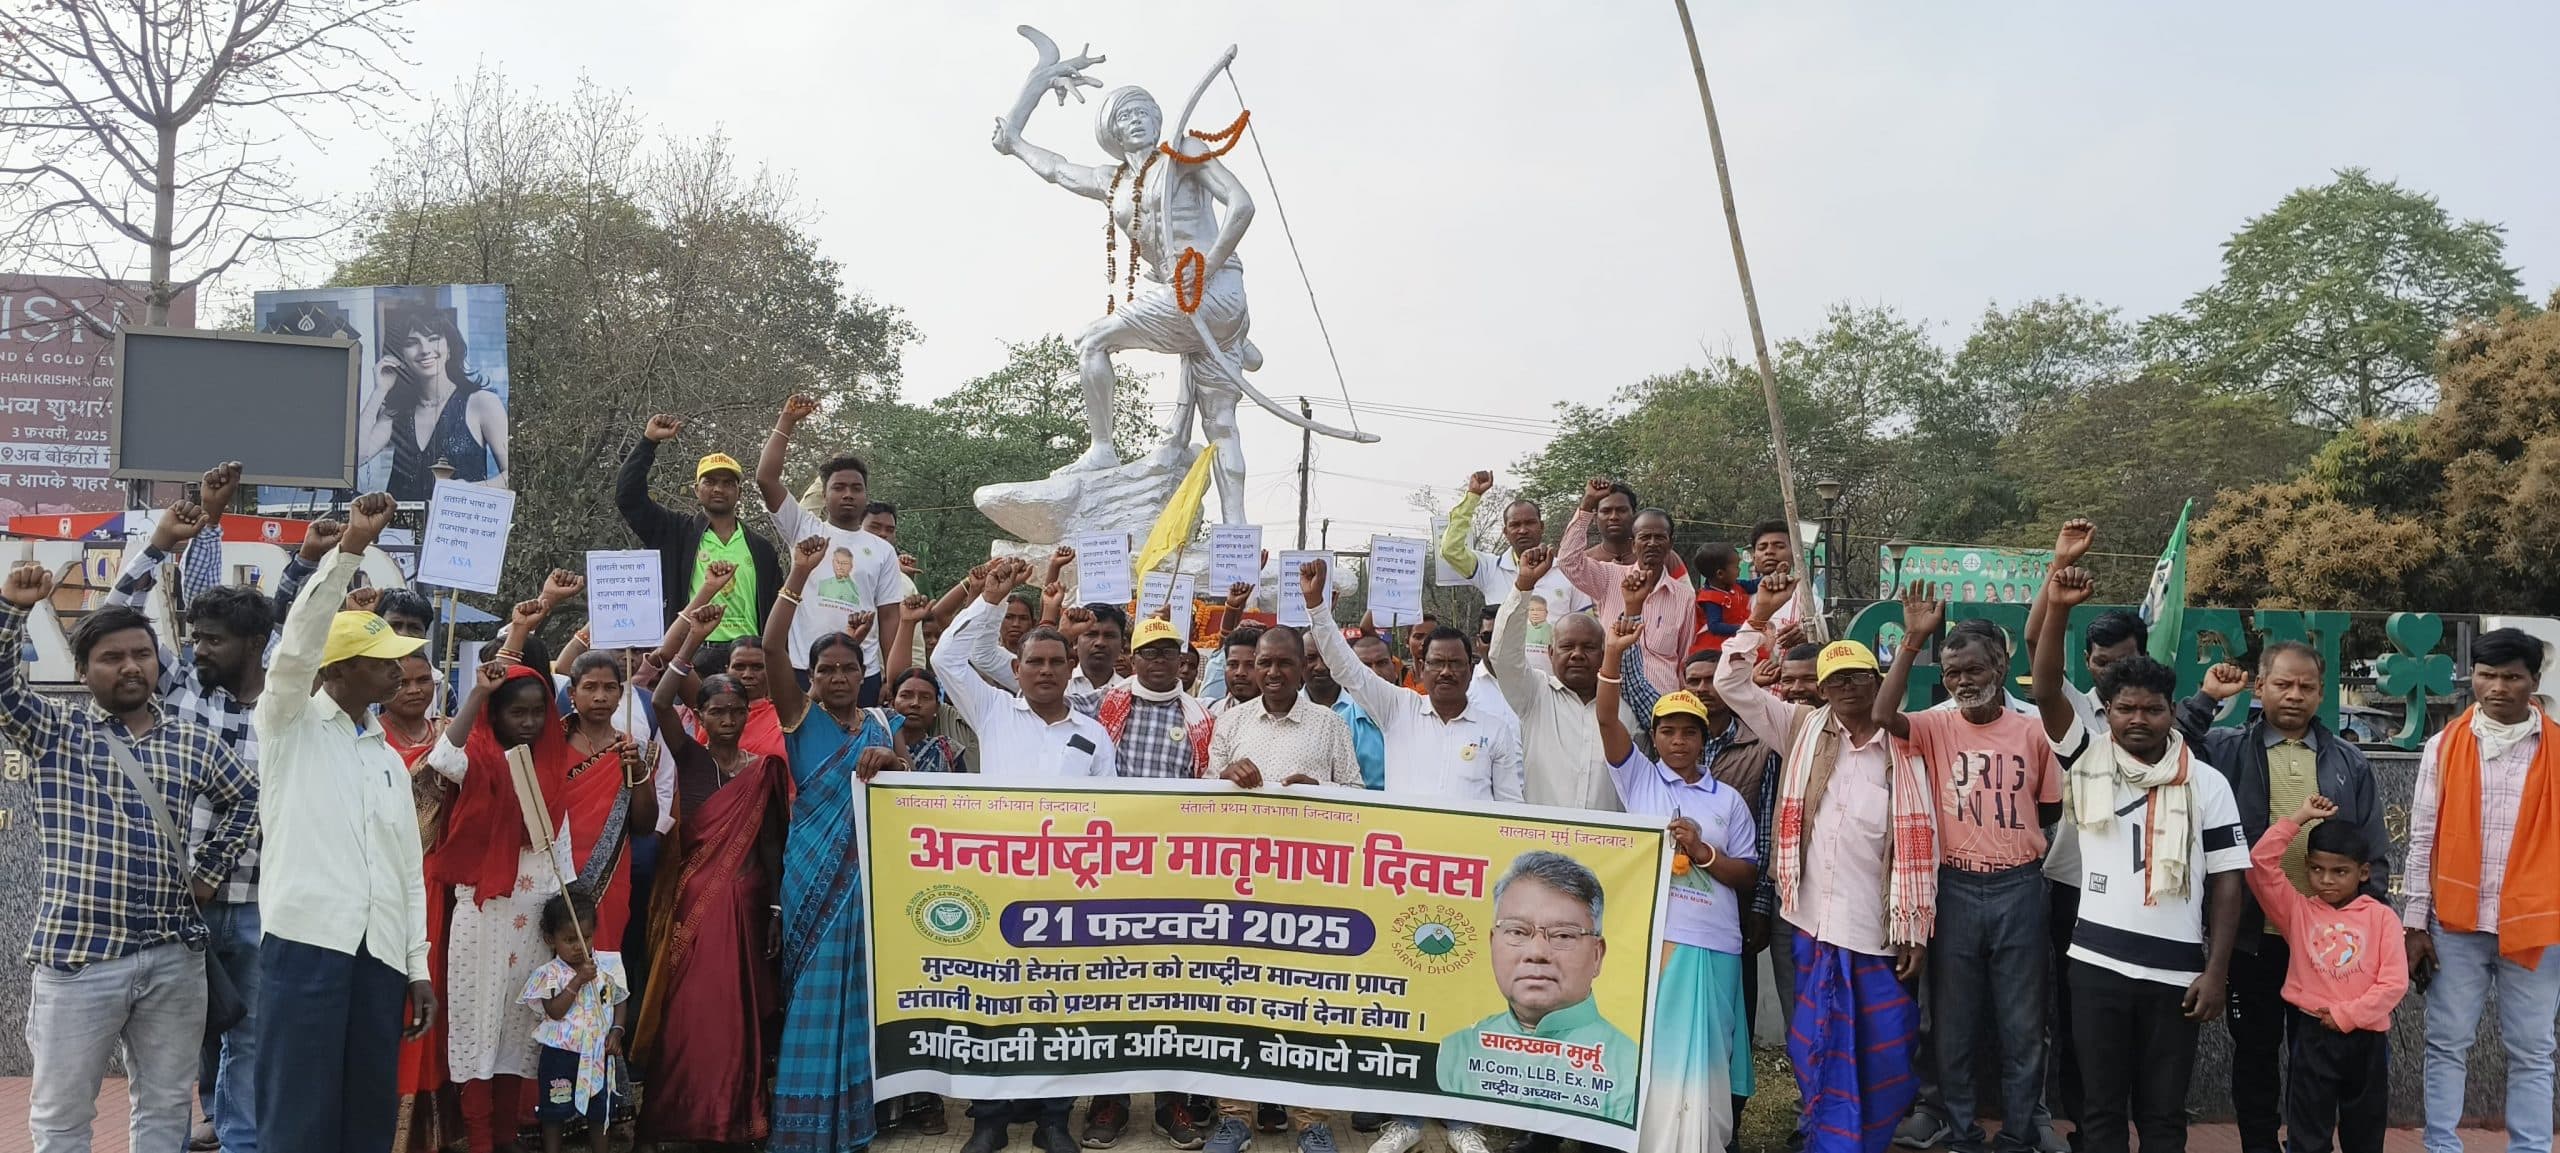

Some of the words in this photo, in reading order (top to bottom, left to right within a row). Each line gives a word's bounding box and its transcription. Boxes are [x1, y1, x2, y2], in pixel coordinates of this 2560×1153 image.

[25, 353, 34, 363] &
[42, 353, 85, 365] GOLD
[12, 427, 20, 438] 3
[74, 430, 108, 441] 2025
[15, 449, 40, 463] अब
[45, 446, 98, 465] बोकारो
[17, 470, 68, 489] आपके
[72, 476, 110, 492] शहर
[449, 556, 472, 568] ASA
[614, 619, 635, 628] ASA
[1144, 622, 1171, 634] SENGEL
[1826, 646, 1855, 662] SENGEL
[1669, 693, 1698, 708] SENGEL
[896, 794, 947, 810] आदिवासी
[952, 794, 981, 811] सेंगेल
[987, 797, 1034, 812] अभियान
[1180, 800, 1216, 815] संताली
[1220, 803, 1247, 815] प्रथम
[1251, 804, 1298, 818] राजभाषा
[1499, 825, 1546, 841] सालखन
[1551, 827, 1571, 848] मुर्मू
[911, 819, 1158, 889] अन्तर्राष्ट्रीय
[1166, 835, 1354, 896] मातृभाषा
[1363, 832, 1489, 896] दिवस
[1022, 905, 1073, 943] 21
[1086, 903, 1234, 941] फरवरी
[1243, 909, 1351, 950] 2025
[1391, 942, 1422, 972] SARNA
[1427, 949, 1477, 974] DHOROM
[921, 957, 1021, 983] मुख्यमंत्री
[1026, 957, 1080, 982] हेमंत
[1086, 955, 1149, 981] सोरेन
[1152, 954, 1183, 980] को
[1188, 956, 1262, 985] राष्ट्रीय
[1267, 966, 1351, 992] मान्यता
[1355, 973, 1408, 996] प्राप्त
[897, 985, 971, 1011] संताली
[975, 994, 1024, 1015] भाषा
[1028, 989, 1059, 1013] को
[1063, 993, 1123, 1014] प्रथम
[1128, 993, 1222, 1012] राजभाषा
[1226, 996, 1257, 1015] का
[1261, 997, 1308, 1022] दर्जा
[1313, 998, 1357, 1025] देना
[1361, 1001, 1410, 1029] होगा
[908, 1025, 1036, 1065] आदिवासी
[1042, 1026, 1118, 1062] सेंगेल
[1123, 1024, 1250, 1069] अभियान,
[1259, 1033, 1352, 1073] बोकारो
[1357, 1042, 1421, 1080] जोन
[1480, 1032, 1563, 1057] सालखन
[1566, 1043, 1605, 1073] मुर्मू
[1468, 1058, 1522, 1079] M.Com,
[1528, 1066, 1560, 1084] LLB,
[1565, 1072, 1586, 1088] Ex.
[1591, 1077, 1614, 1093] MP
[1481, 1080, 1519, 1097] राष्ट्रीय
[1573, 1093, 1600, 1109] ASA
